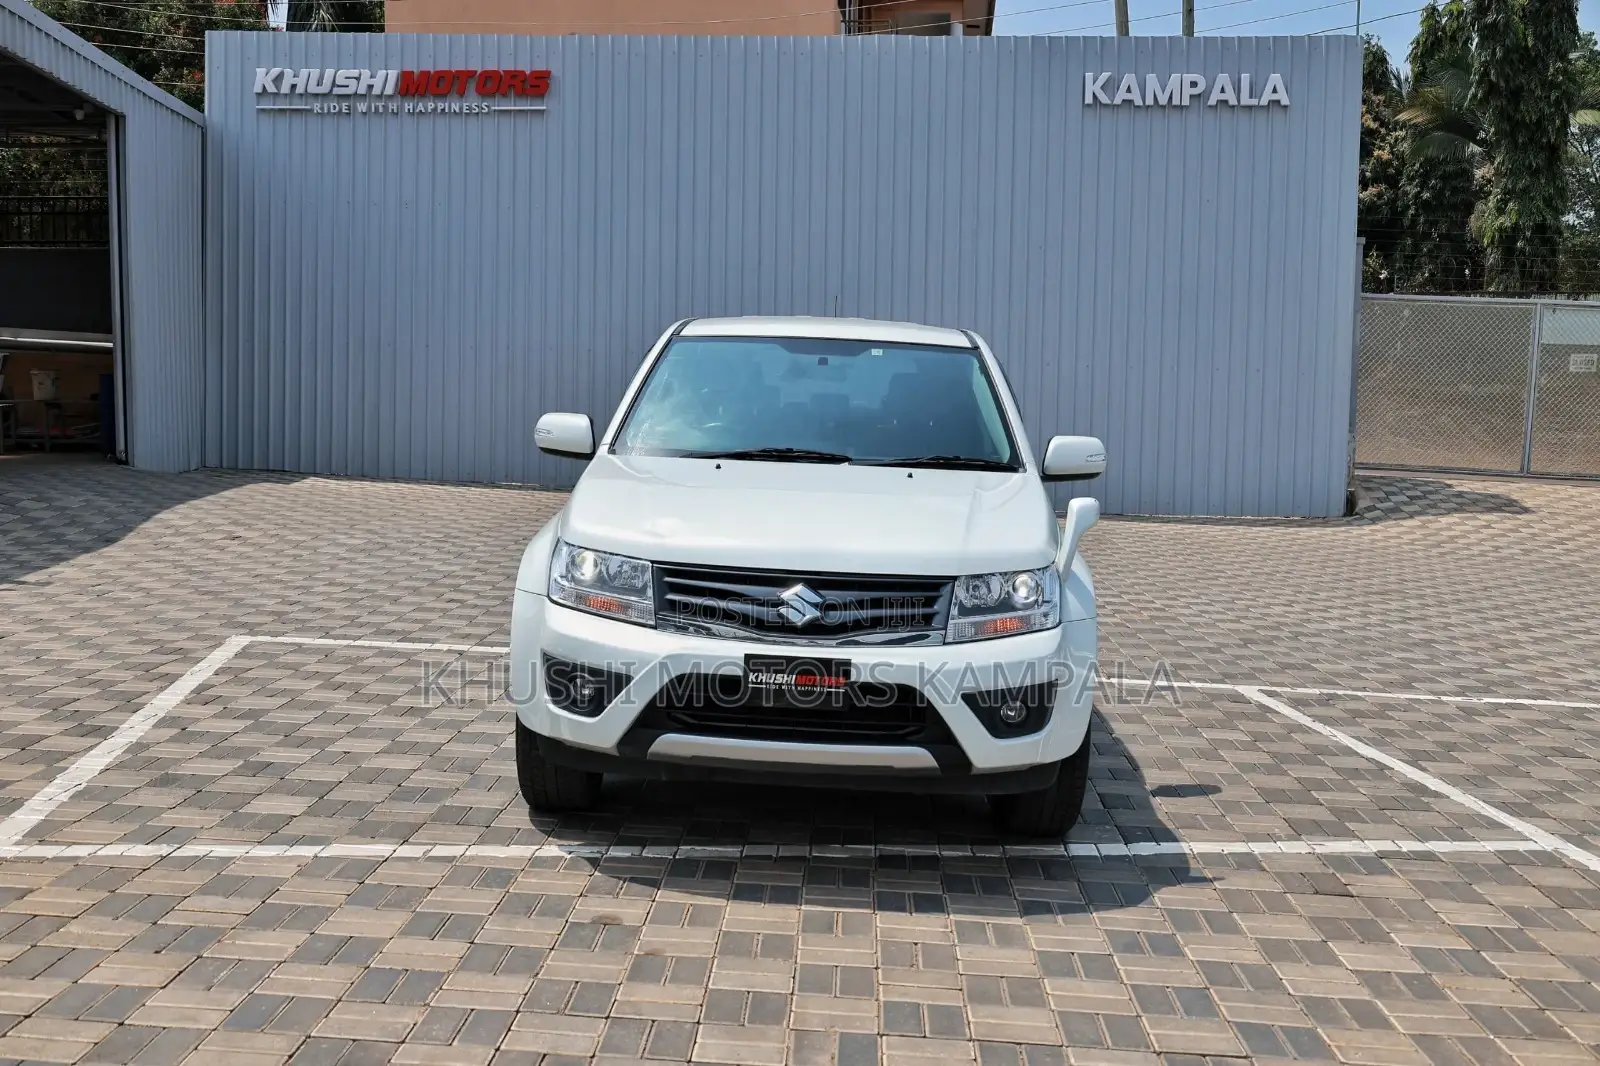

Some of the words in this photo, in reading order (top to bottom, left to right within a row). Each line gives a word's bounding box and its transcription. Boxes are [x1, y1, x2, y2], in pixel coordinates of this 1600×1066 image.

[1084, 72, 1290, 106] KAMPALA
[313, 102, 350, 114] RIDE
[357, 102, 398, 114] WITH
[404, 102, 490, 114] HAPPINESS
